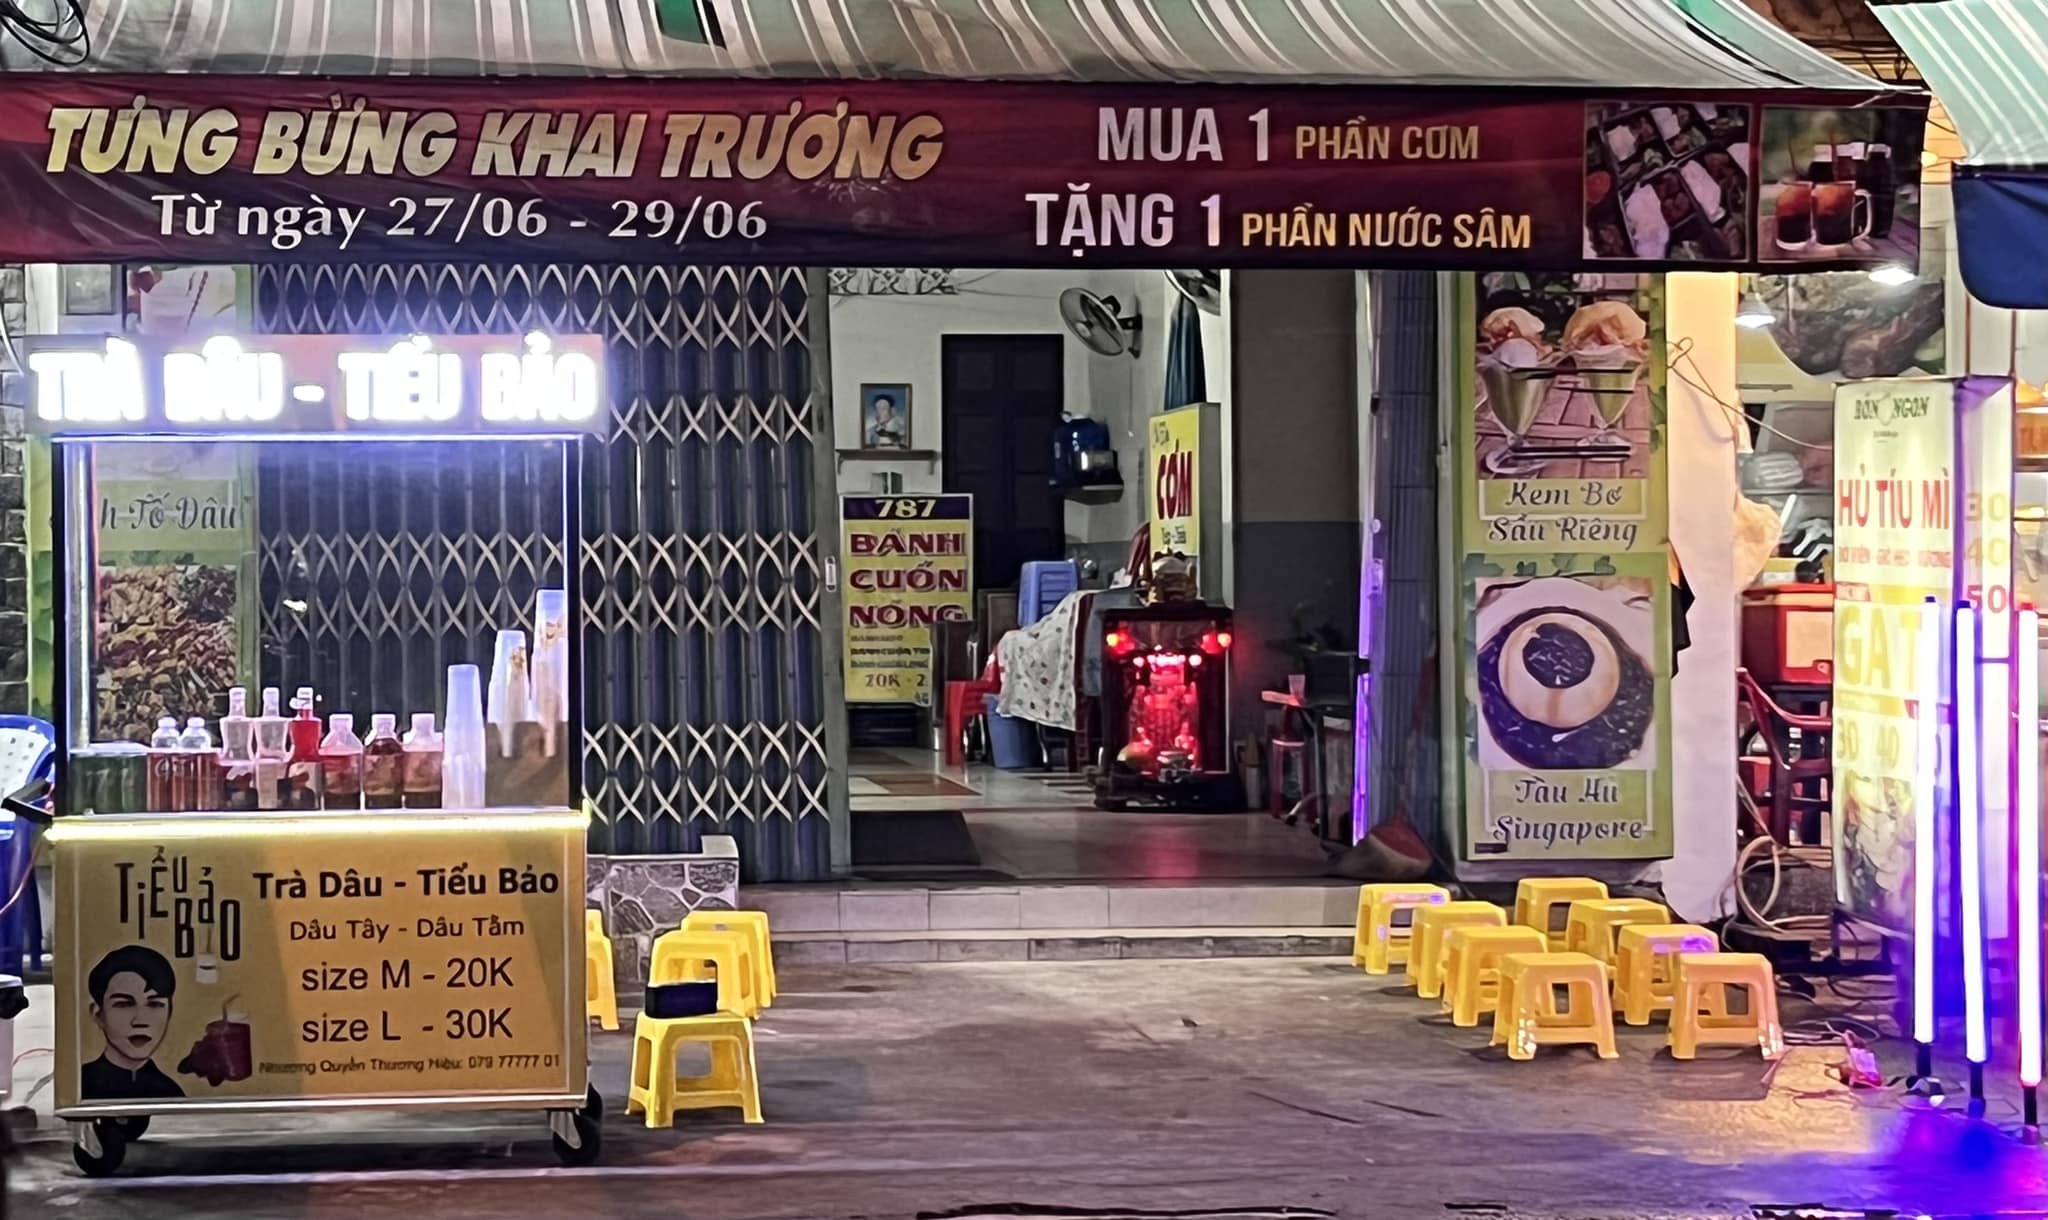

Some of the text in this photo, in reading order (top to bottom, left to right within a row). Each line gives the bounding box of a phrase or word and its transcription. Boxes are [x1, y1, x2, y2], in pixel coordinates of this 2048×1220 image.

[46, 93, 945, 180] TƯNG BỪNG KHAI TRƯƠNG
[1098, 107, 1479, 161] MUA 1 PHẦN CƠM
[151, 193, 768, 249] Từ ngày 27/06 - 29/06
[1025, 183, 1531, 257] TẶNG 1 PHẦN NƯỚC SÂM
[293, 385, 325, 402] -
[875, 499, 936, 518] 787
[1505, 481, 1570, 506] Kem
[175, 496, 236, 531] Dâu
[1555, 516, 1638, 550] Riêng
[850, 560, 968, 592] CUỐN
[1493, 815, 1643, 850] Singapore
[252, 869, 307, 899] Trà
[319, 868, 382, 898] Dâu
[416, 862, 486, 896] Tiểu
[498, 864, 559, 895] Bảo
[290, 918, 337, 941] Dâu
[346, 917, 390, 943] Tây
[416, 916, 464, 938] Dâu
[301, 961, 369, 991] size
[381, 958, 411, 990] M
[446, 957, 514, 989] 20K
[302, 1012, 369, 1043] size
[381, 1010, 401, 1041] L
[446, 1007, 513, 1040] 30K
[544, 1054, 560, 1067] 01
